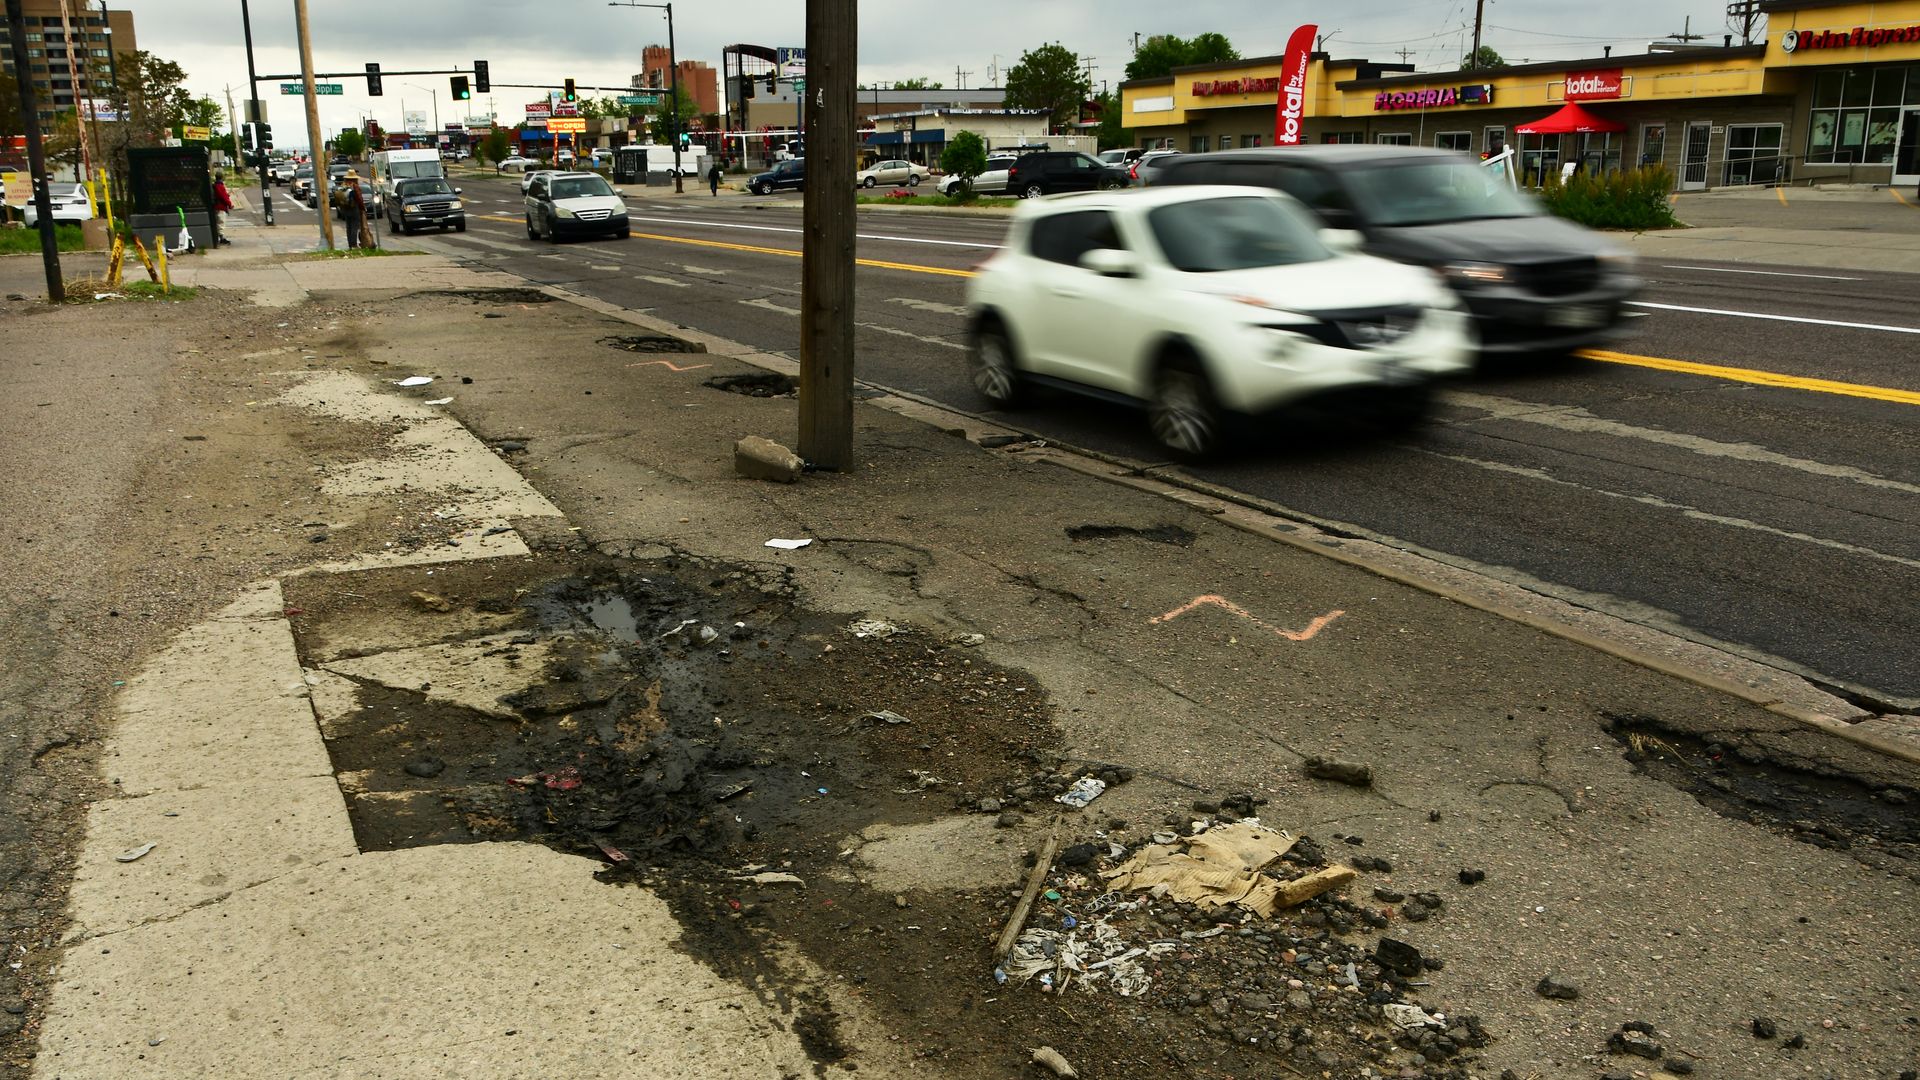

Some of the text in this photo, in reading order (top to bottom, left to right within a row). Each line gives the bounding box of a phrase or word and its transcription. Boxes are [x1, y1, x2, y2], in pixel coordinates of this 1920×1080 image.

[1798, 27, 1920, 49] Relax Express
[1298, 55, 1307, 88] verizon
[1567, 76, 1605, 94] total by
[1280, 75, 1303, 143] total by
[1374, 88, 1456, 110] FLORERIA
